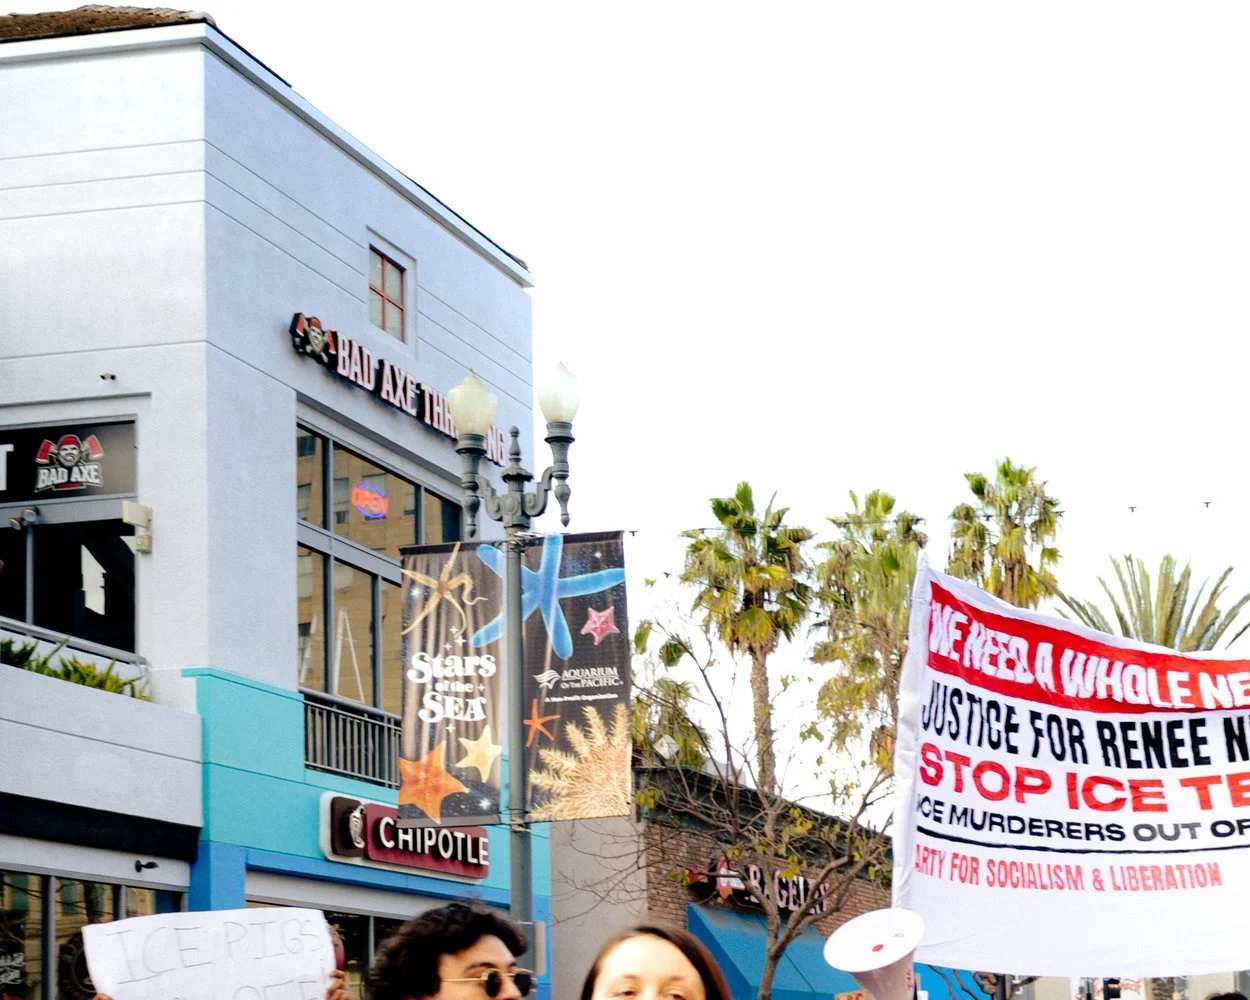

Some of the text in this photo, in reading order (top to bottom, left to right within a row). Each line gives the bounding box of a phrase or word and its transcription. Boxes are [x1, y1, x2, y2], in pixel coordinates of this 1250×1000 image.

[336, 331, 505, 467] BAD AXE THRNG
[40, 464, 100, 489] BAD AXE
[406, 652, 497, 684] Stars
[561, 666, 619, 680] AQUARIUM
[930, 600, 968, 662] WE
[963, 620, 1034, 684] NEED
[1035, 642, 1056, 693] A
[1060, 648, 1195, 709] WHOLE
[435, 680, 473, 692] of the
[922, 680, 1020, 754] JUSTICE
[1029, 710, 1088, 765] FOR
[1096, 718, 1211, 769] RENEE
[919, 742, 1052, 804] STOP
[1066, 772, 1168, 812] ICE
[379, 816, 489, 865] CHIPOTLE
[948, 804, 1126, 842] MURDERERS
[1133, 822, 1202, 842] OUT
[950, 852, 981, 886] FOR
[986, 858, 1084, 891] SOCIALISM
[1092, 867, 1105, 891] &
[1109, 862, 1223, 892] LIBERATION
[107, 926, 213, 985] ICE
